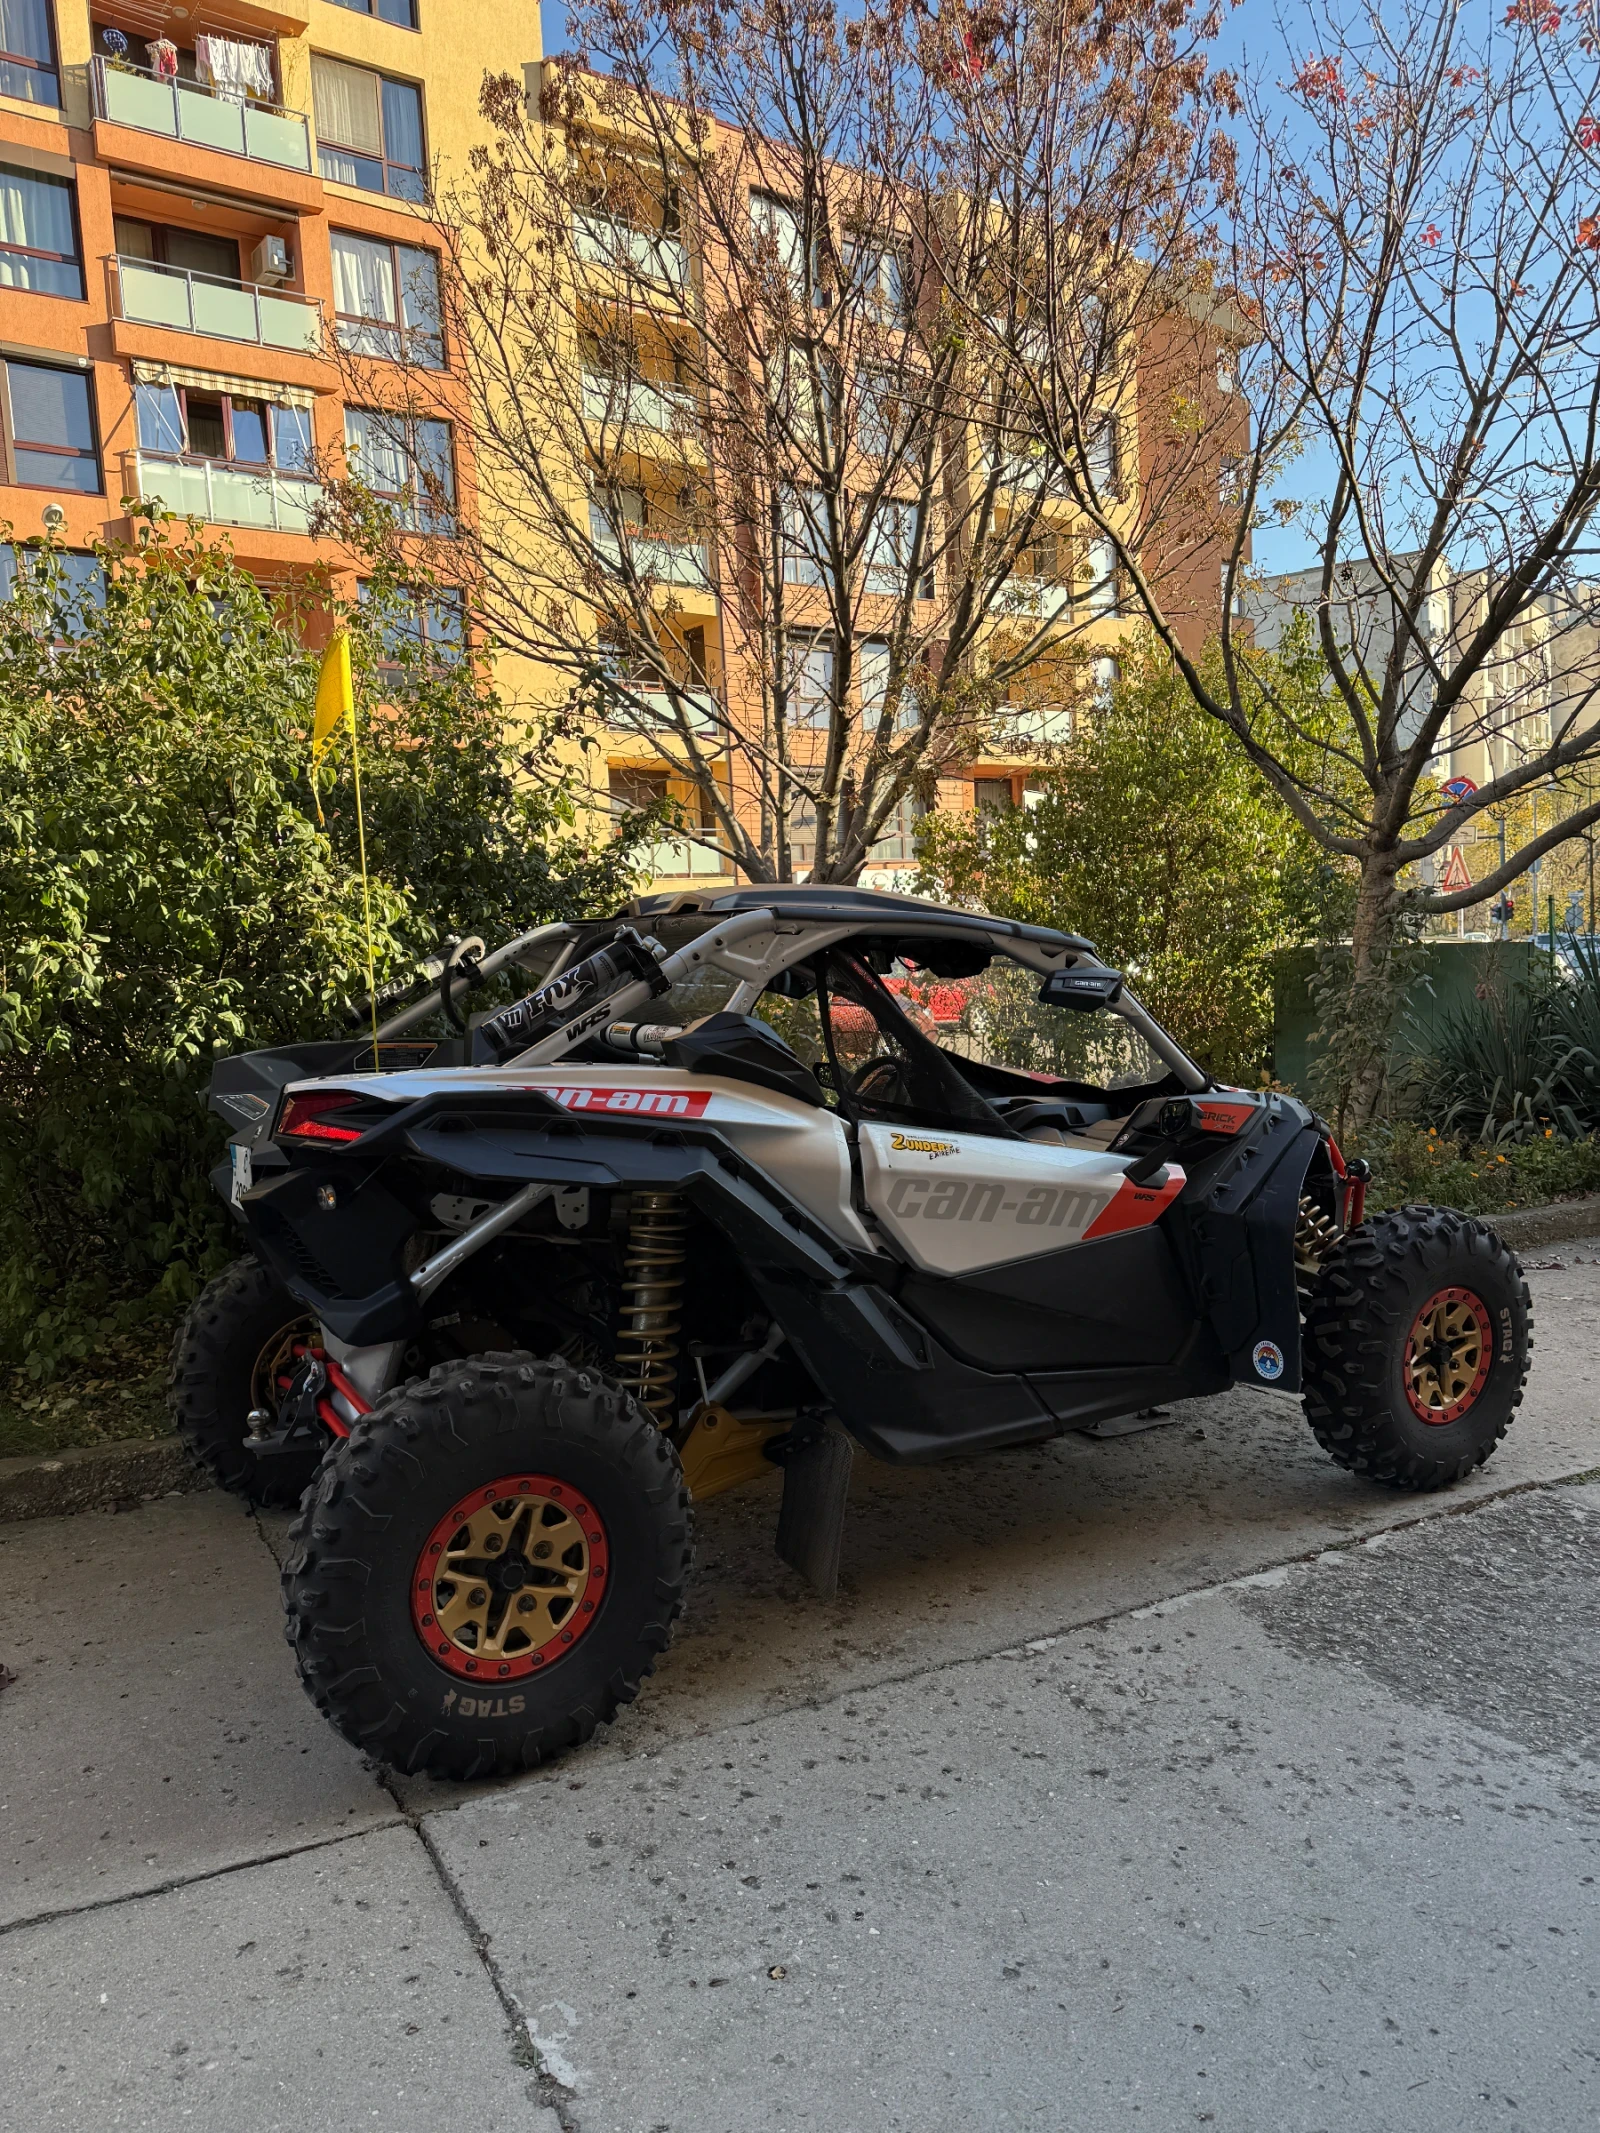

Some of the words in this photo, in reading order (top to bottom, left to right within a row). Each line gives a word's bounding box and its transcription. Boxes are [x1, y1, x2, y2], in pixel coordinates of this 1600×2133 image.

[526, 966, 580, 1020] FOX
[886, 1178, 1112, 1229] can-am
[1499, 1307, 1513, 1352] STAG
[457, 1694, 526, 1718] STAG
